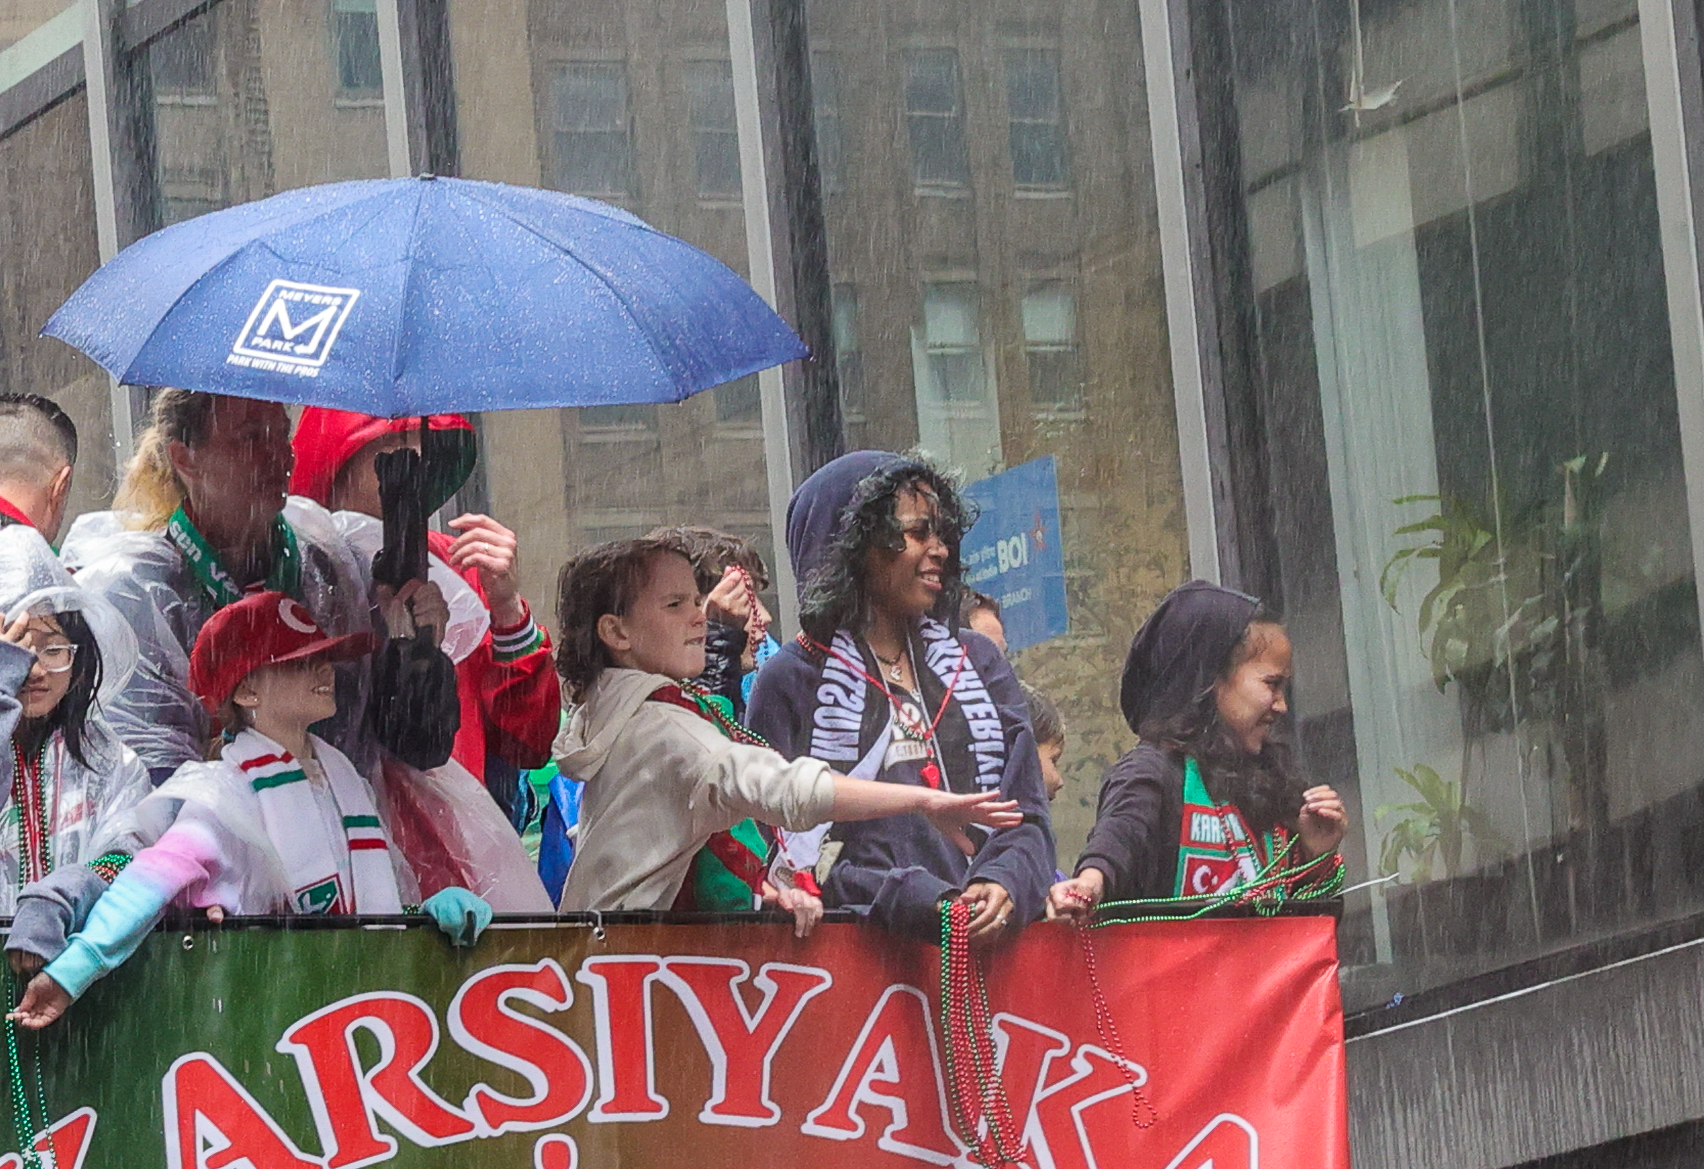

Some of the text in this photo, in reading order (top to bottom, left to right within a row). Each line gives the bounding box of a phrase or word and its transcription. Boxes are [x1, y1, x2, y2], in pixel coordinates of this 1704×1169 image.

[278, 289, 343, 306] MEYERS
[251, 336, 295, 352] PARK
[226, 353, 321, 378] PARK WITH THE PROS
[997, 532, 1029, 574] BOI
